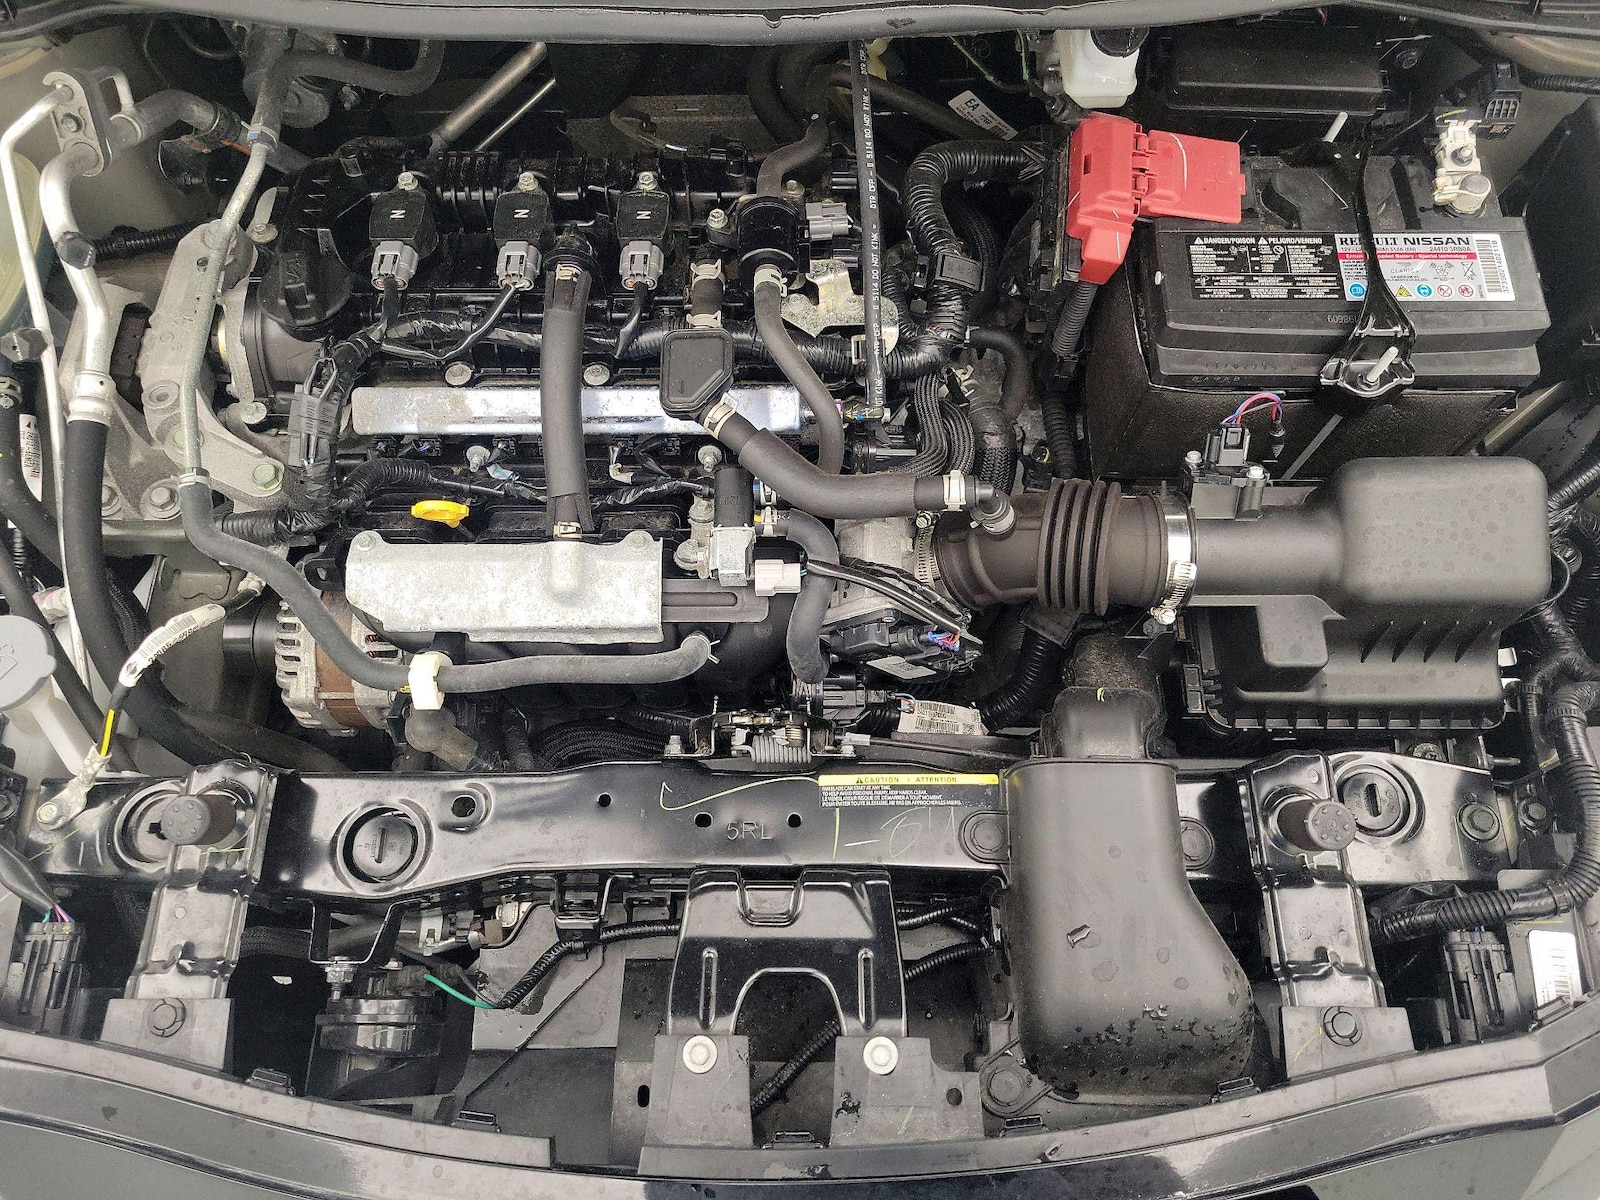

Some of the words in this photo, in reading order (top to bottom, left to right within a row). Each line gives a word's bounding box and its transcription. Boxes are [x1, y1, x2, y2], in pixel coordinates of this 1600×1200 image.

[964, 98, 980, 111] EA
[863, 114, 871, 127] NOT
[871, 232, 879, 250] KINK
[1339, 237, 1398, 246] REULT
[1403, 237, 1470, 246] NISSAN
[871, 253, 879, 267] NOT
[871, 270, 879, 280] DO
[864, 776, 900, 784] CAUTION
[726, 821, 772, 841] 5RL
